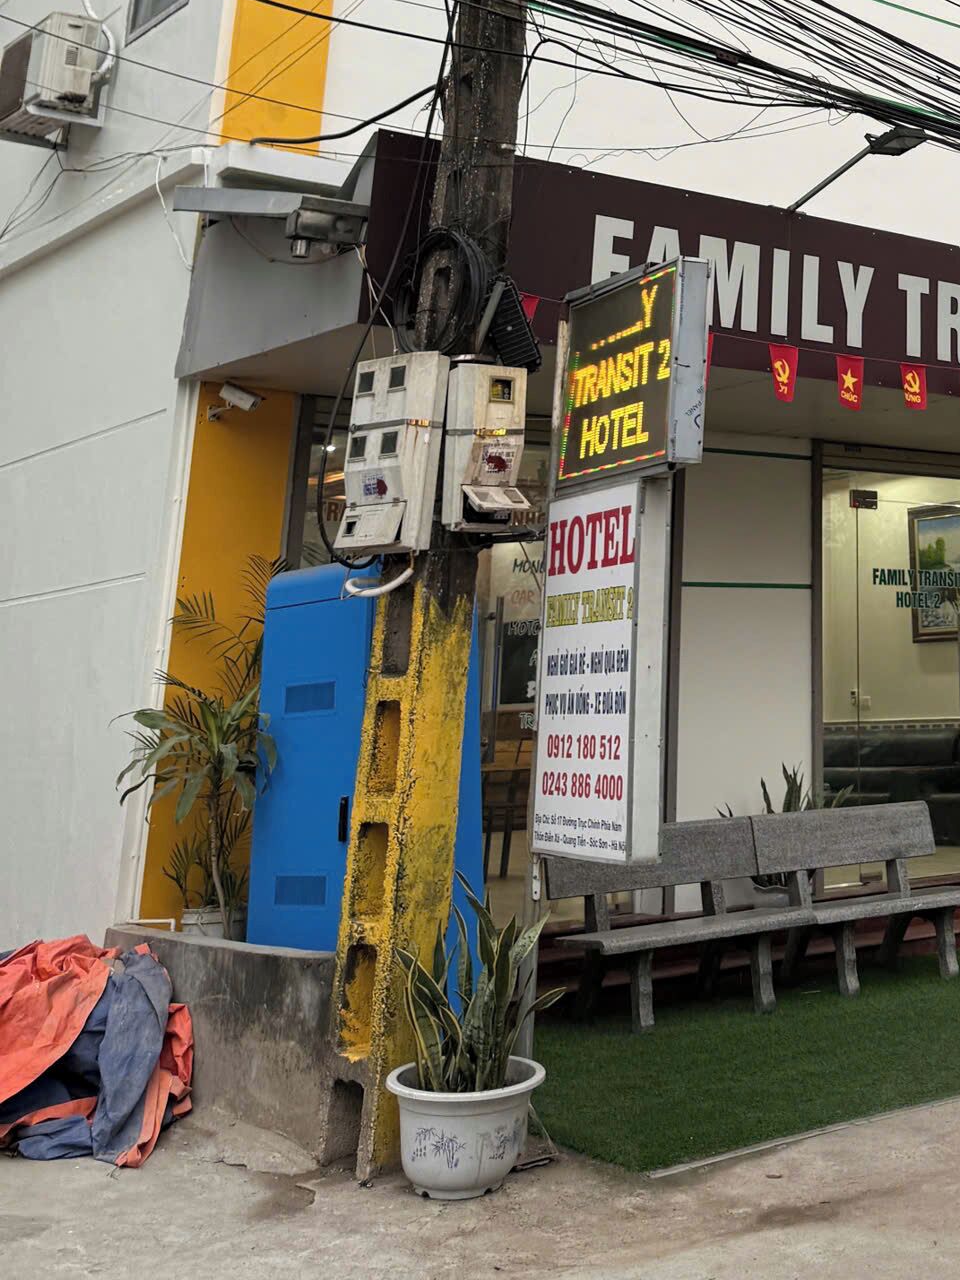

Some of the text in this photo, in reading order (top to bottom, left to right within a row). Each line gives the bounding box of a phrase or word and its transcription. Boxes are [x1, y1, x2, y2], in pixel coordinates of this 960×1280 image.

[575, 338, 671, 408] TRANSIT 2
[579, 401, 650, 459] HOTEL
[548, 505, 635, 576] HOTEL
[872, 568, 915, 586] FAMILY
[511, 589, 536, 607] CAR
[546, 592, 581, 628] FAMILY
[582, 585, 626, 624] TRANSIT
[896, 591, 941, 609] HOTEL 2
[547, 734, 621, 760] 0912 180 512
[542, 771, 623, 801] 0243 886 4000
